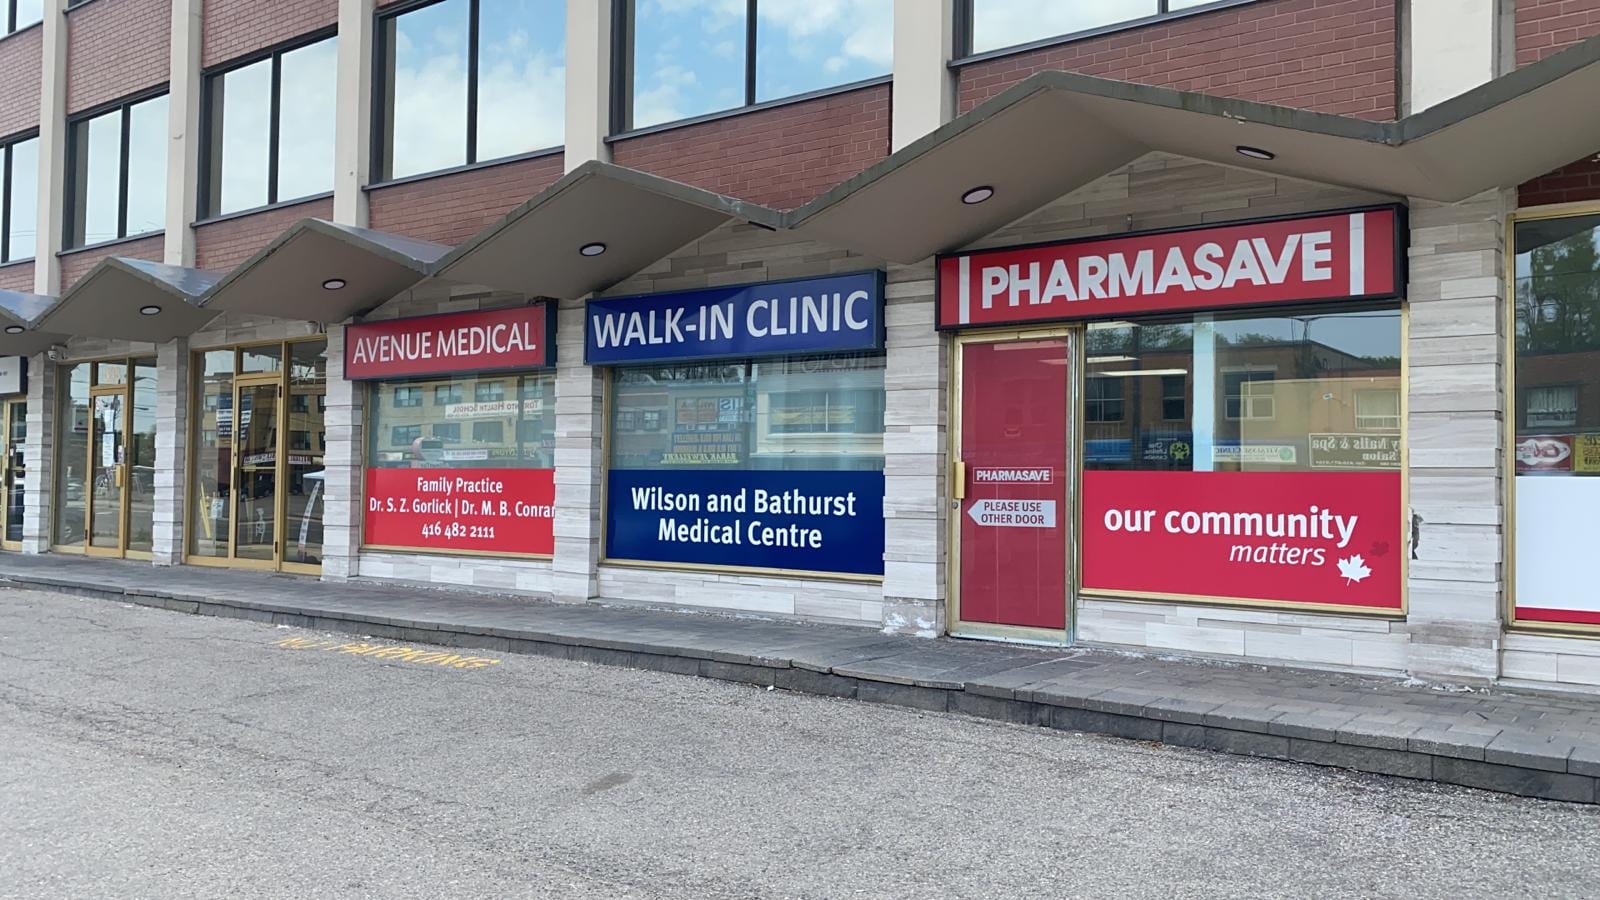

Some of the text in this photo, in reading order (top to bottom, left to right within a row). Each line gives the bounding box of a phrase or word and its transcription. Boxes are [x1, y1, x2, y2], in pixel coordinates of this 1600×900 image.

[981, 230, 1333, 309] PHARMASAVE
[593, 290, 869, 348] WALK-IN CLINIC
[352, 322, 536, 364] AVENUE MEDICAL
[417, 476, 503, 496] Family Practice
[976, 470, 1050, 481] PHARMASAVE
[370, 497, 384, 512] Dr.
[387, 497, 397, 513] S.
[400, 498, 410, 514] Z.
[413, 498, 451, 515] Gorlick
[461, 500, 478, 516] Dr.
[481, 501, 496, 516] M.
[500, 501, 512, 517] B.
[631, 487, 857, 516] Wilson and Bathurst
[984, 501, 1042, 512] PLEASE USE
[422, 521, 495, 539] 416 482 2111
[981, 514, 1045, 525] OTHER DOOR
[1104, 505, 1358, 549] our community
[658, 518, 823, 548] Medical Centre
[1229, 542, 1326, 566] matters
